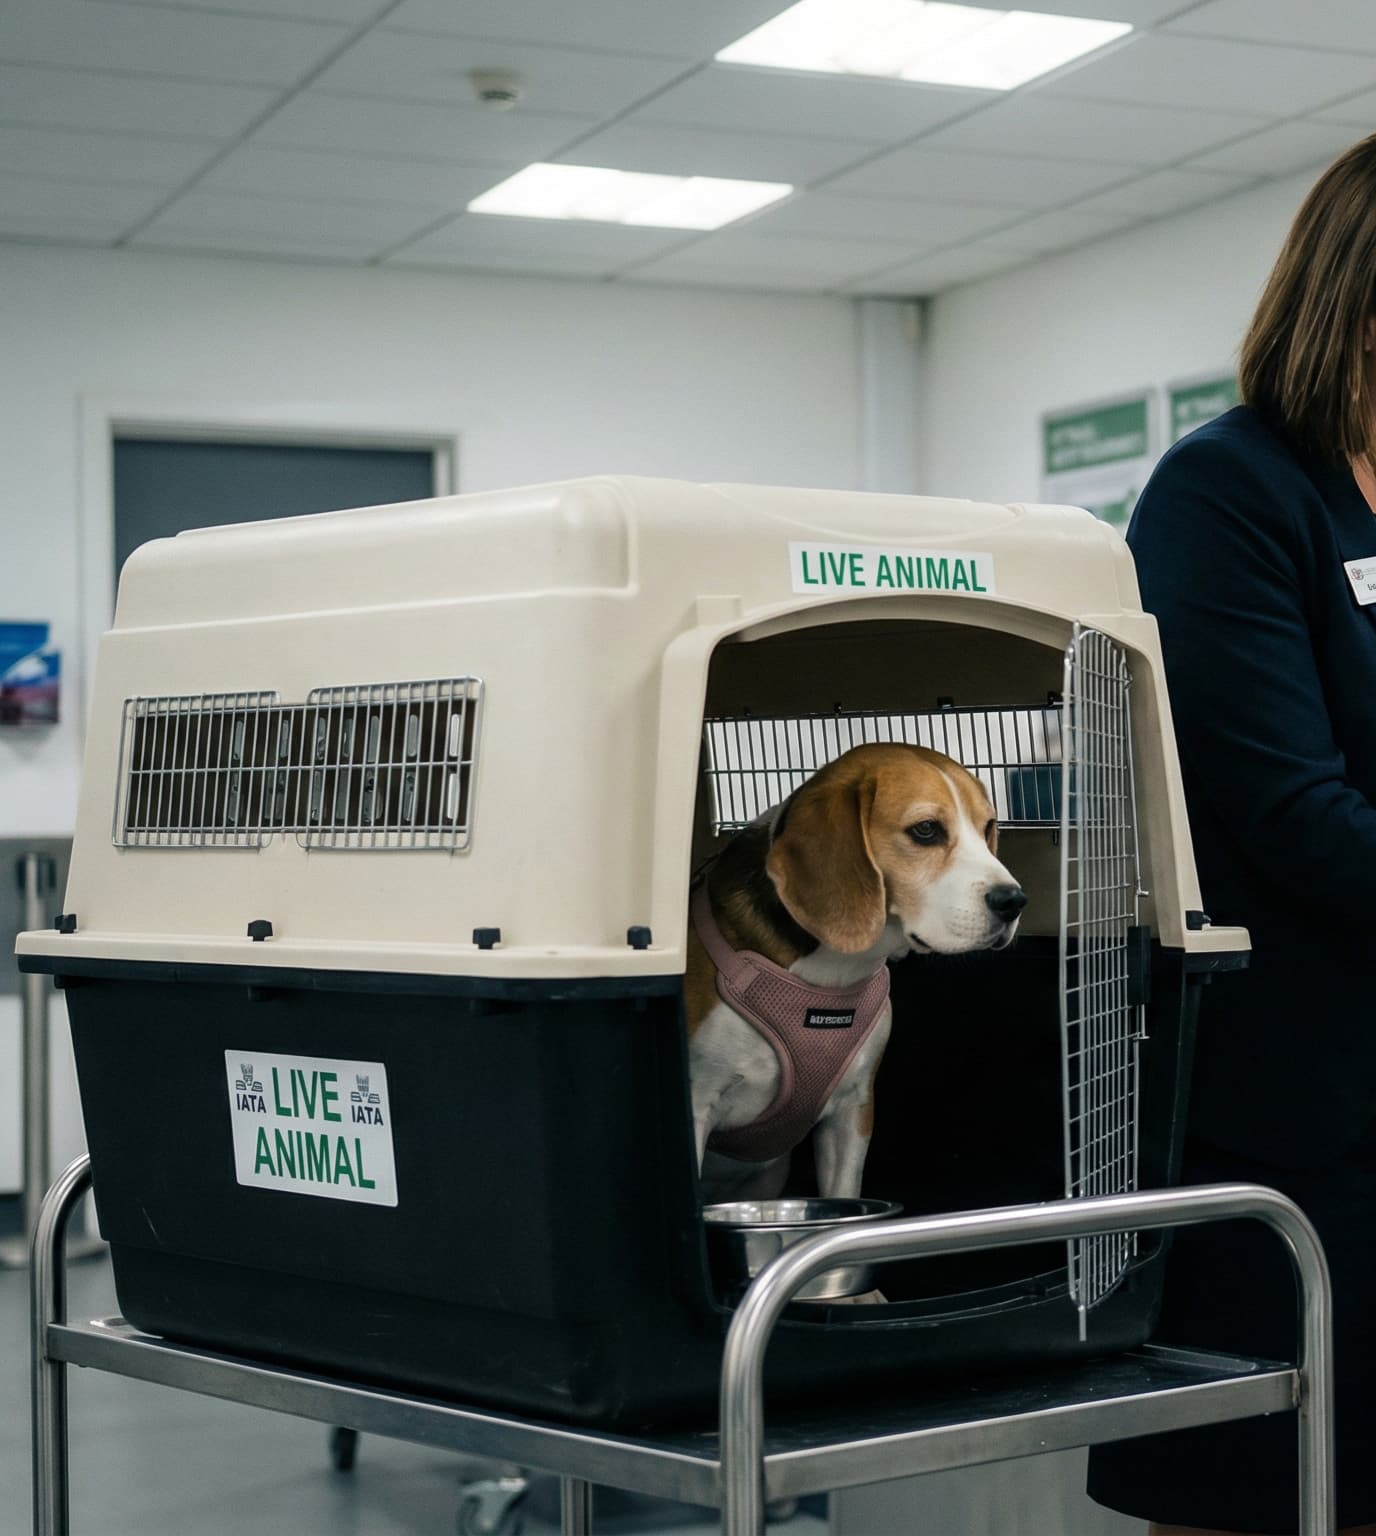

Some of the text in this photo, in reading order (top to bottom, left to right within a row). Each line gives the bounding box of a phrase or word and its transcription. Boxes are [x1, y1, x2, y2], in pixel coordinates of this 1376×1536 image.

[801, 551, 987, 592] LIVE ANIMAL
[236, 1093, 266, 1113] IATA
[272, 1067, 342, 1122] LIVE
[351, 1105, 384, 1126] IATA
[254, 1126, 376, 1189] ANIMAL
